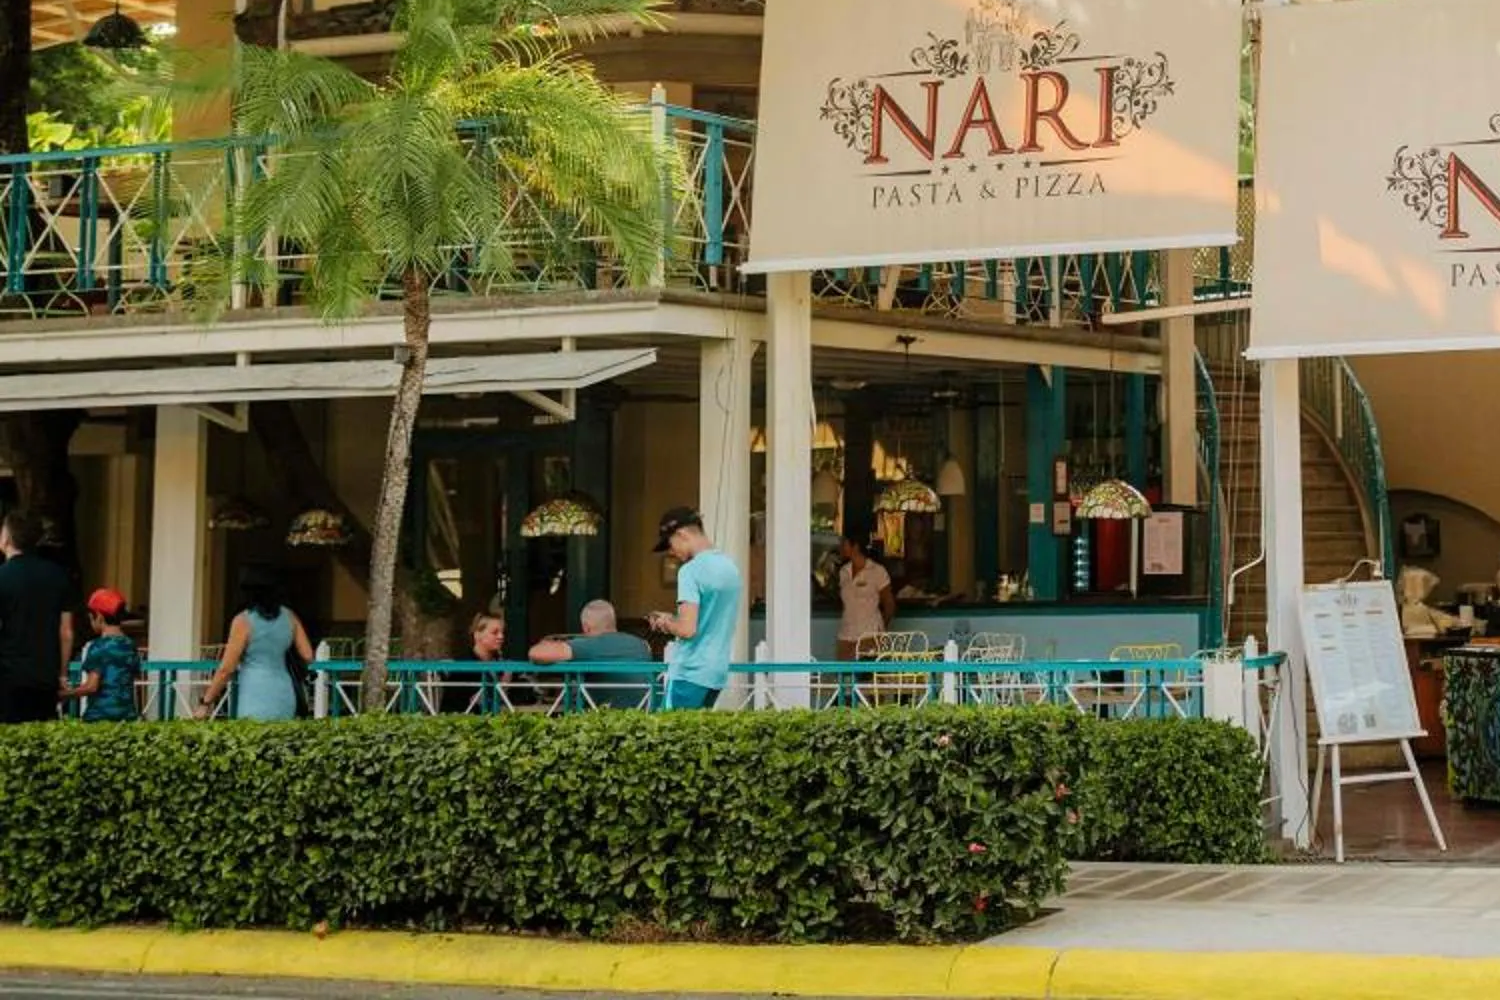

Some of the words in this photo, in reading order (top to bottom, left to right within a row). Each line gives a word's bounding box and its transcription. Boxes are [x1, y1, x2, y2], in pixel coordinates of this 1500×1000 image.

[864, 66, 1120, 164] NARI
[872, 176, 963, 209] PASTA
[979, 180, 997, 201] &
[1015, 172, 1106, 199] PIZZA
